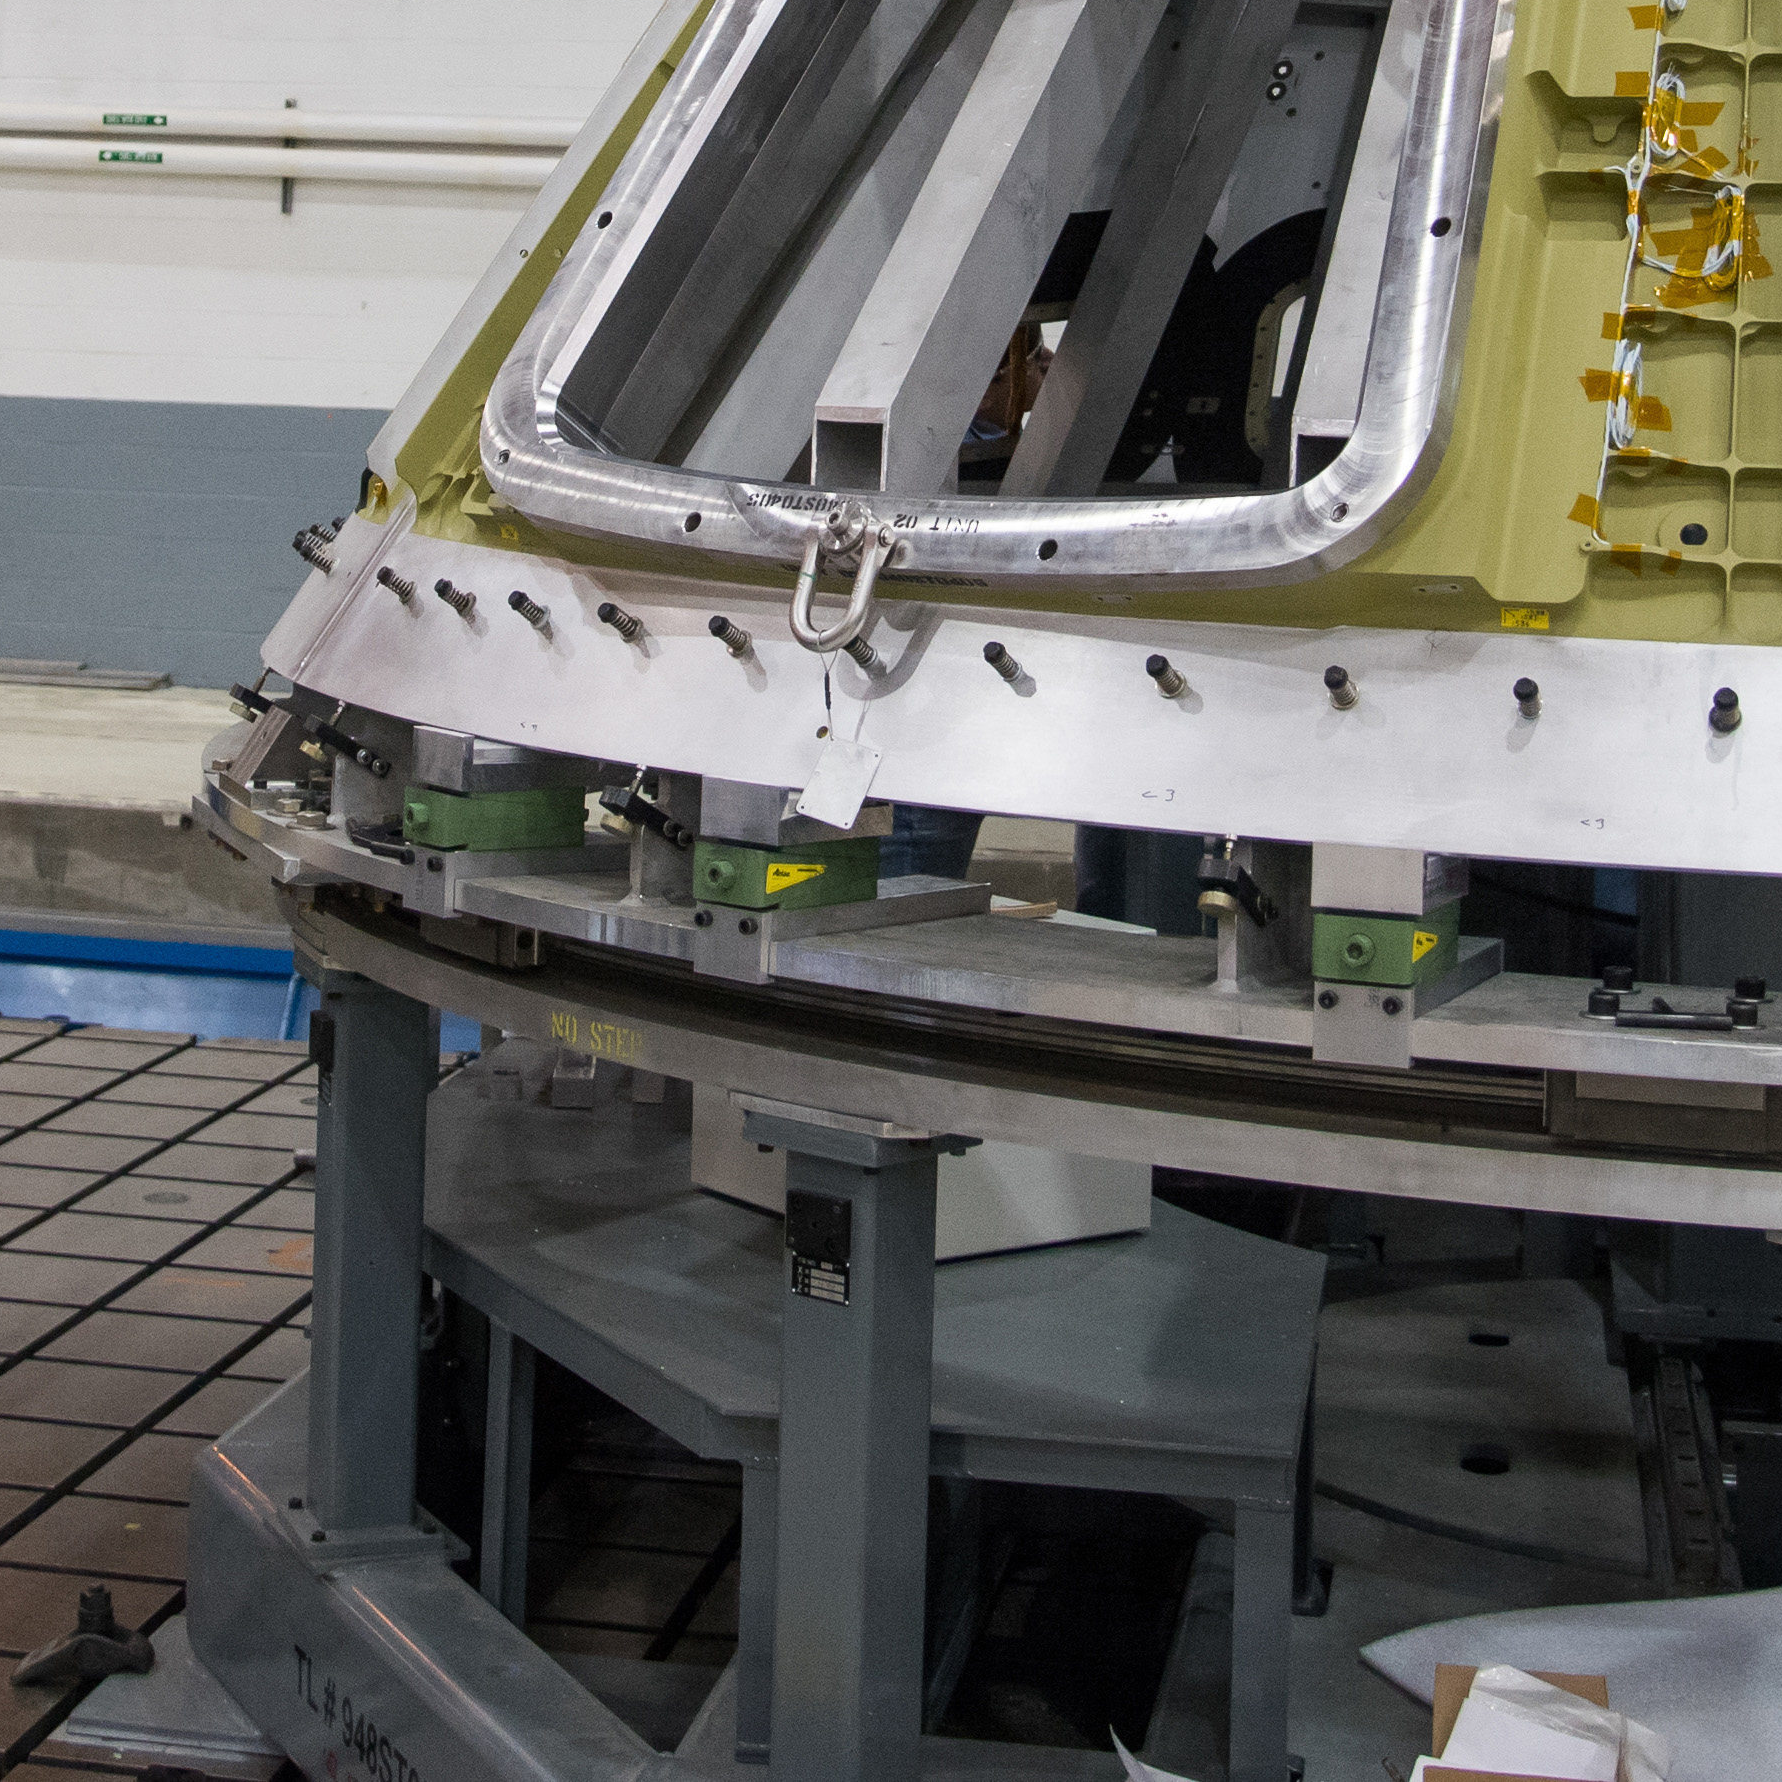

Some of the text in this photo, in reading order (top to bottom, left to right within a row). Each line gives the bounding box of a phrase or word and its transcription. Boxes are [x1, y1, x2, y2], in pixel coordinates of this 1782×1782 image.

[893, 513, 919, 529] 02
[928, 516, 980, 534] UNIT
[551, 1010, 578, 1045] NO
[293, 1643, 319, 1714] TL
[341, 1695, 421, 1782] 948ST
